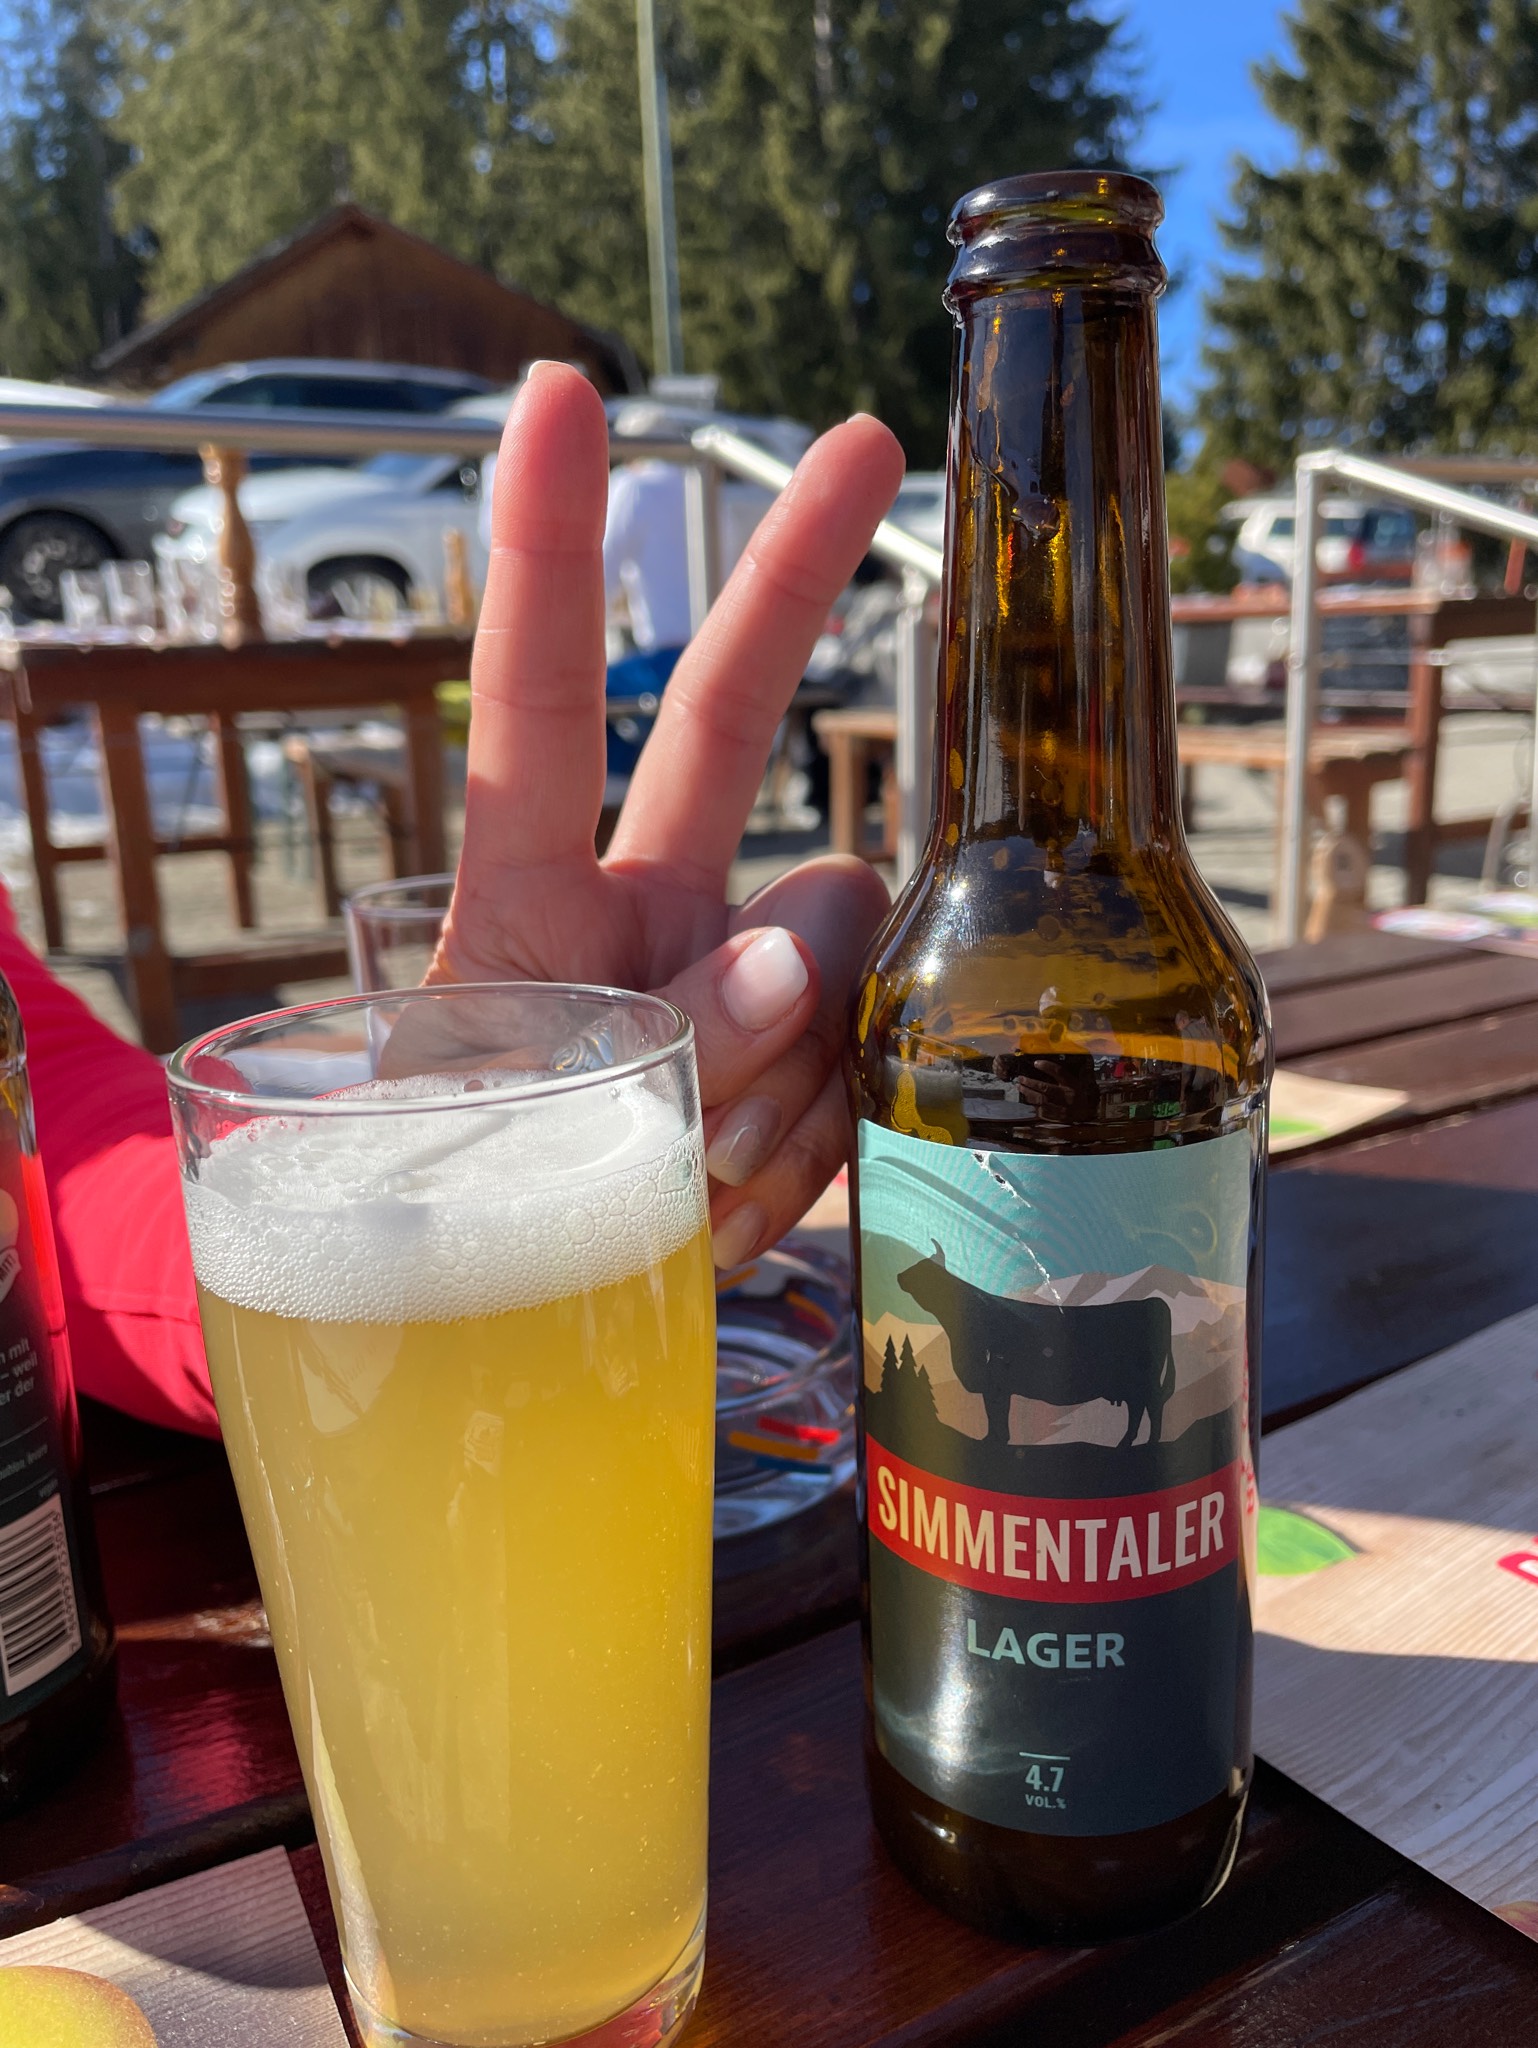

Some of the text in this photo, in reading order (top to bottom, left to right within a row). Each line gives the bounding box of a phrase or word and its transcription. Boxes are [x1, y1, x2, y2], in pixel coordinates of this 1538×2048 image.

[9, 1337, 30, 1361] mit
[12, 1350, 38, 1378] weil
[15, 1376, 35, 1398] der
[877, 1466, 1225, 1582] SIMMENTALER
[967, 1618, 1126, 1669] LAGER
[1025, 1764, 1065, 1792] 4.7
[1025, 1794, 1067, 1809] VOL.%
